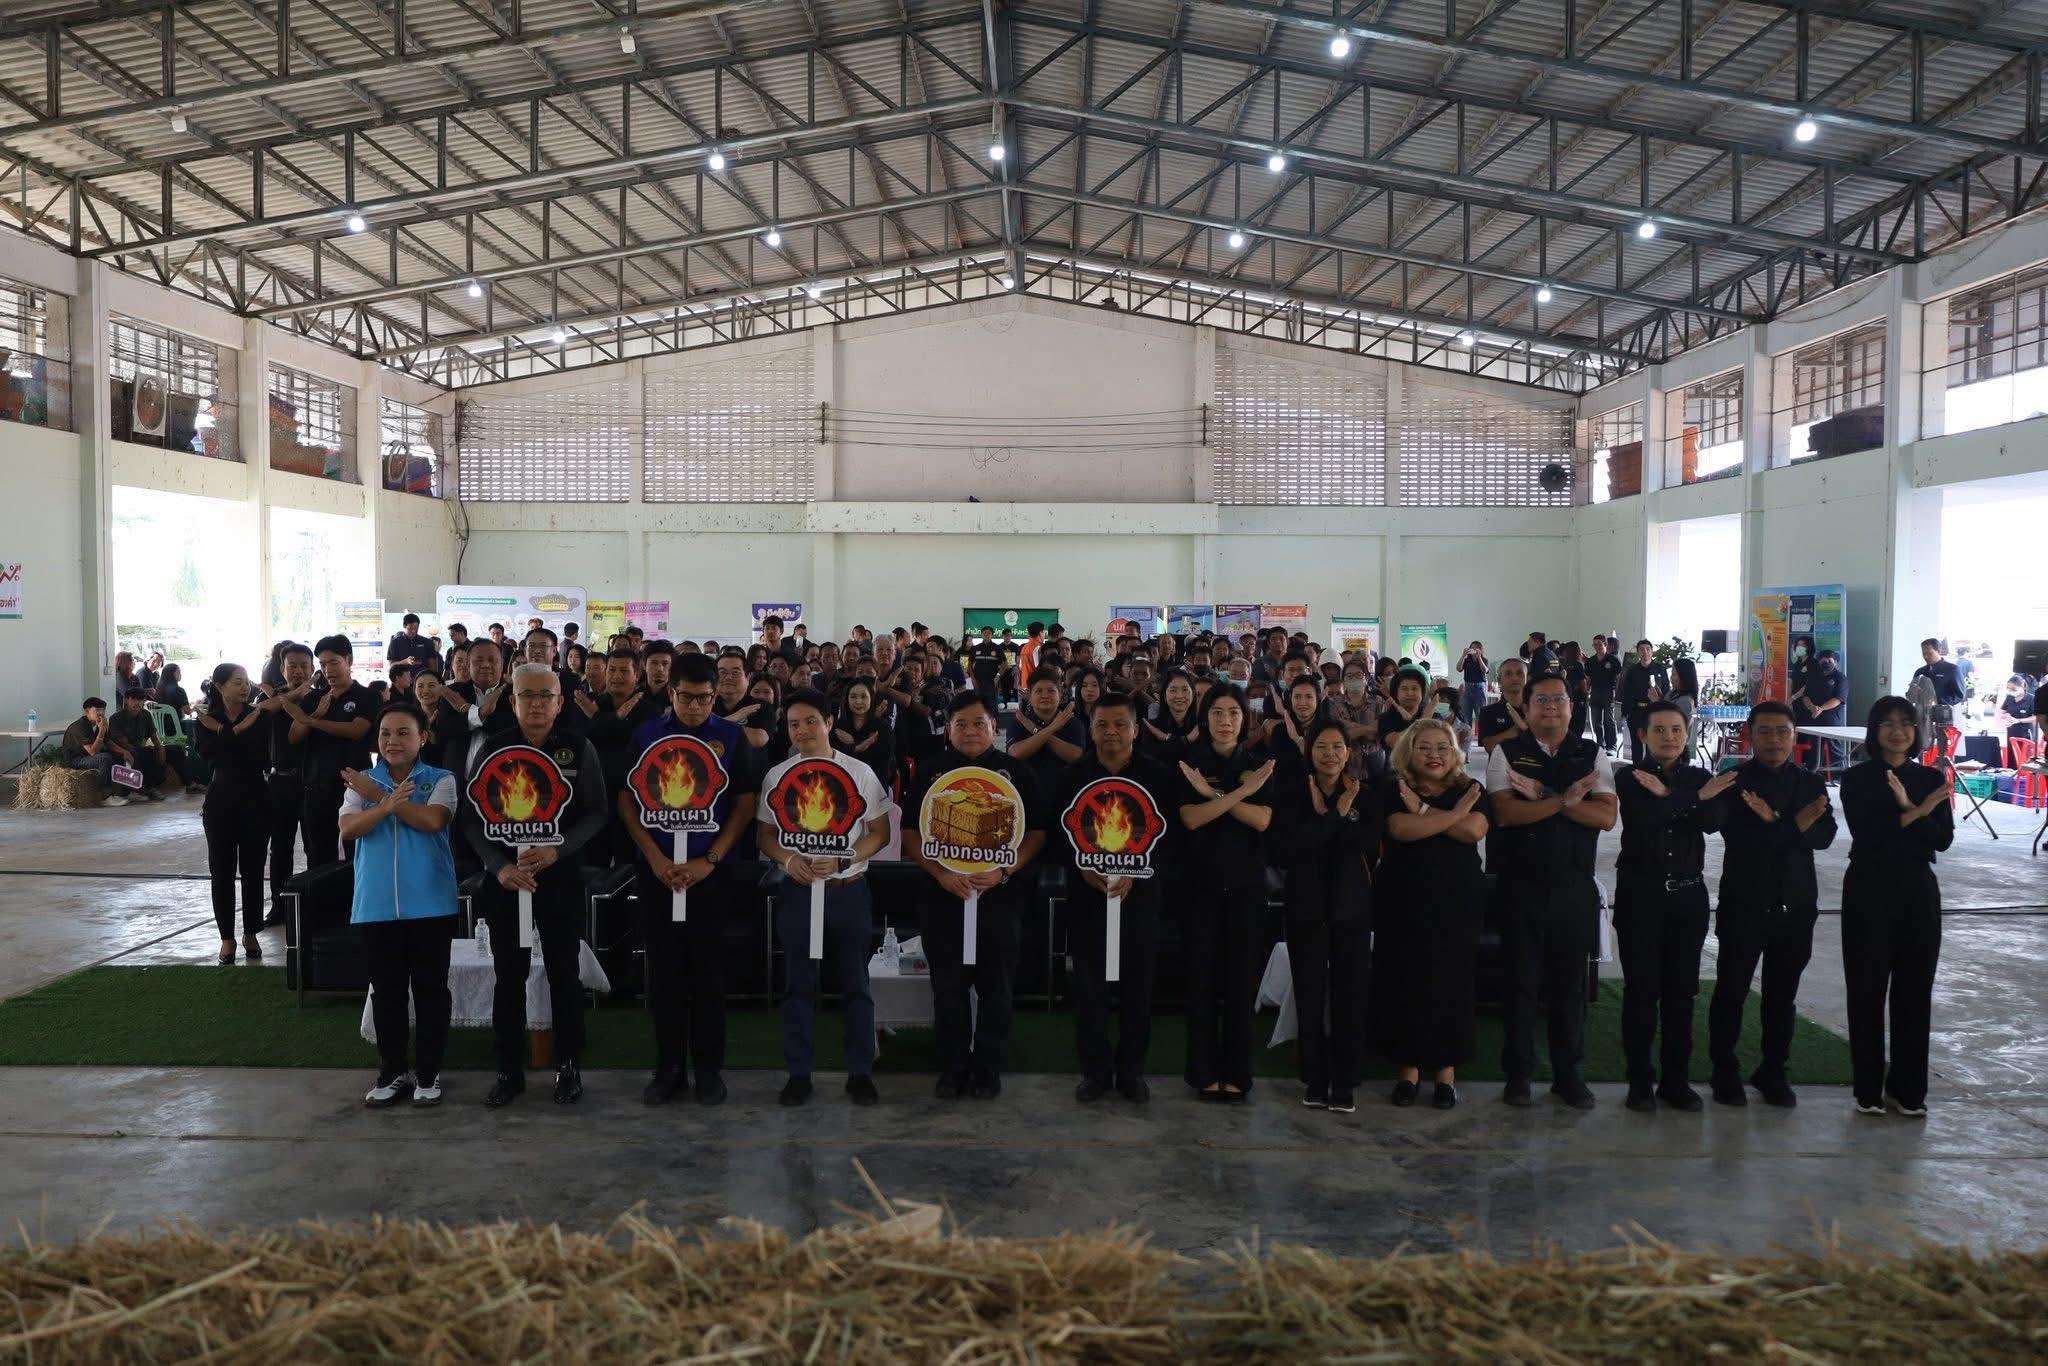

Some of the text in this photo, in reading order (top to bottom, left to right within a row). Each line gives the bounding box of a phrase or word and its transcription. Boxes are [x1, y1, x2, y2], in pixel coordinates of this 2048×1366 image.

[646, 810, 708, 826] หยุดเผา
[489, 822, 553, 839] หยุดเผา
[784, 833, 846, 849] หยุดเผา
[925, 841, 1015, 864] ฟางทองคำ
[1081, 853, 1144, 870] หยุดเผา
